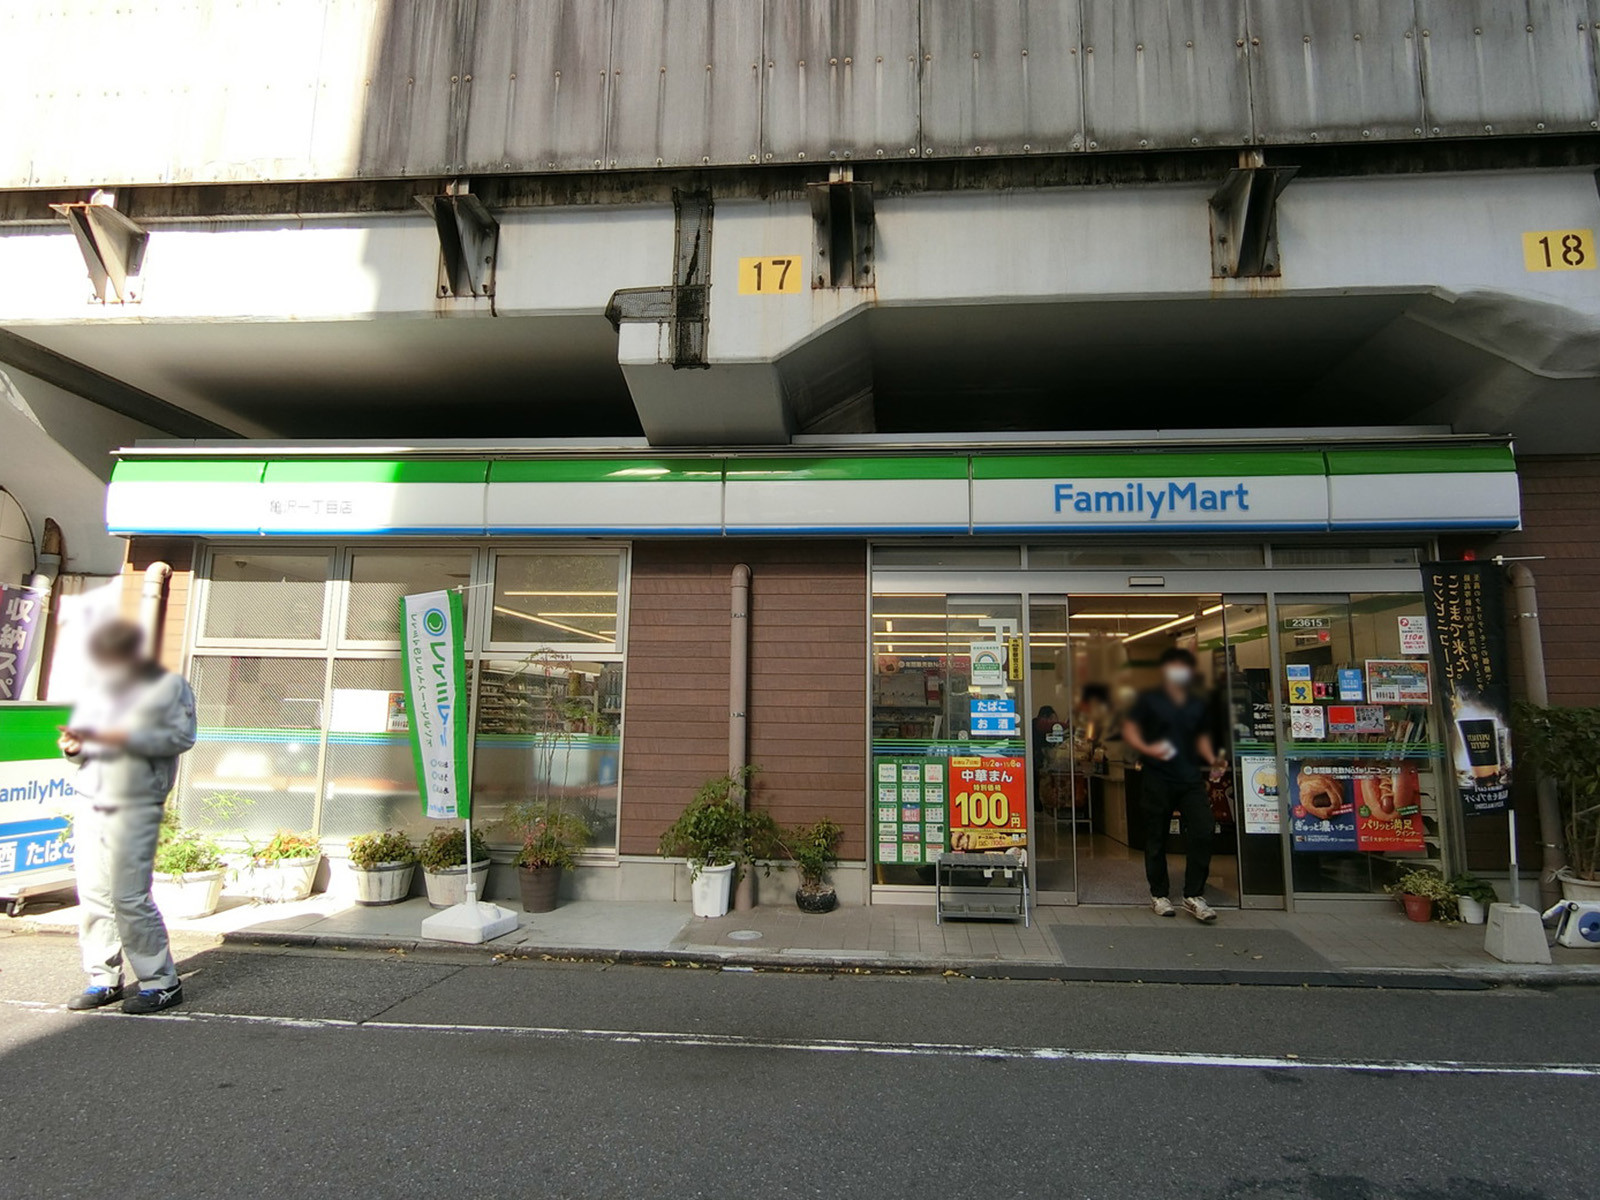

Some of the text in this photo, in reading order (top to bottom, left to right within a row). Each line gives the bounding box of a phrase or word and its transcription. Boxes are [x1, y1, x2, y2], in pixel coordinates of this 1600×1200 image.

[1539, 234, 1585, 267] 18
[753, 260, 792, 291] 17
[1054, 482, 1249, 519] FamilyMart
[1292, 619, 1323, 627] 23615
[977, 701, 1008, 711] たばこ
[961, 769, 1013, 783] 中華まん
[0, 778, 78, 804] amilyMa
[955, 792, 1009, 827] 100
[1011, 817, 1021, 828] 円
[1294, 820, 1355, 832] ぎゅっと濃いチョコ
[1360, 819, 1414, 831] パリッと満足
